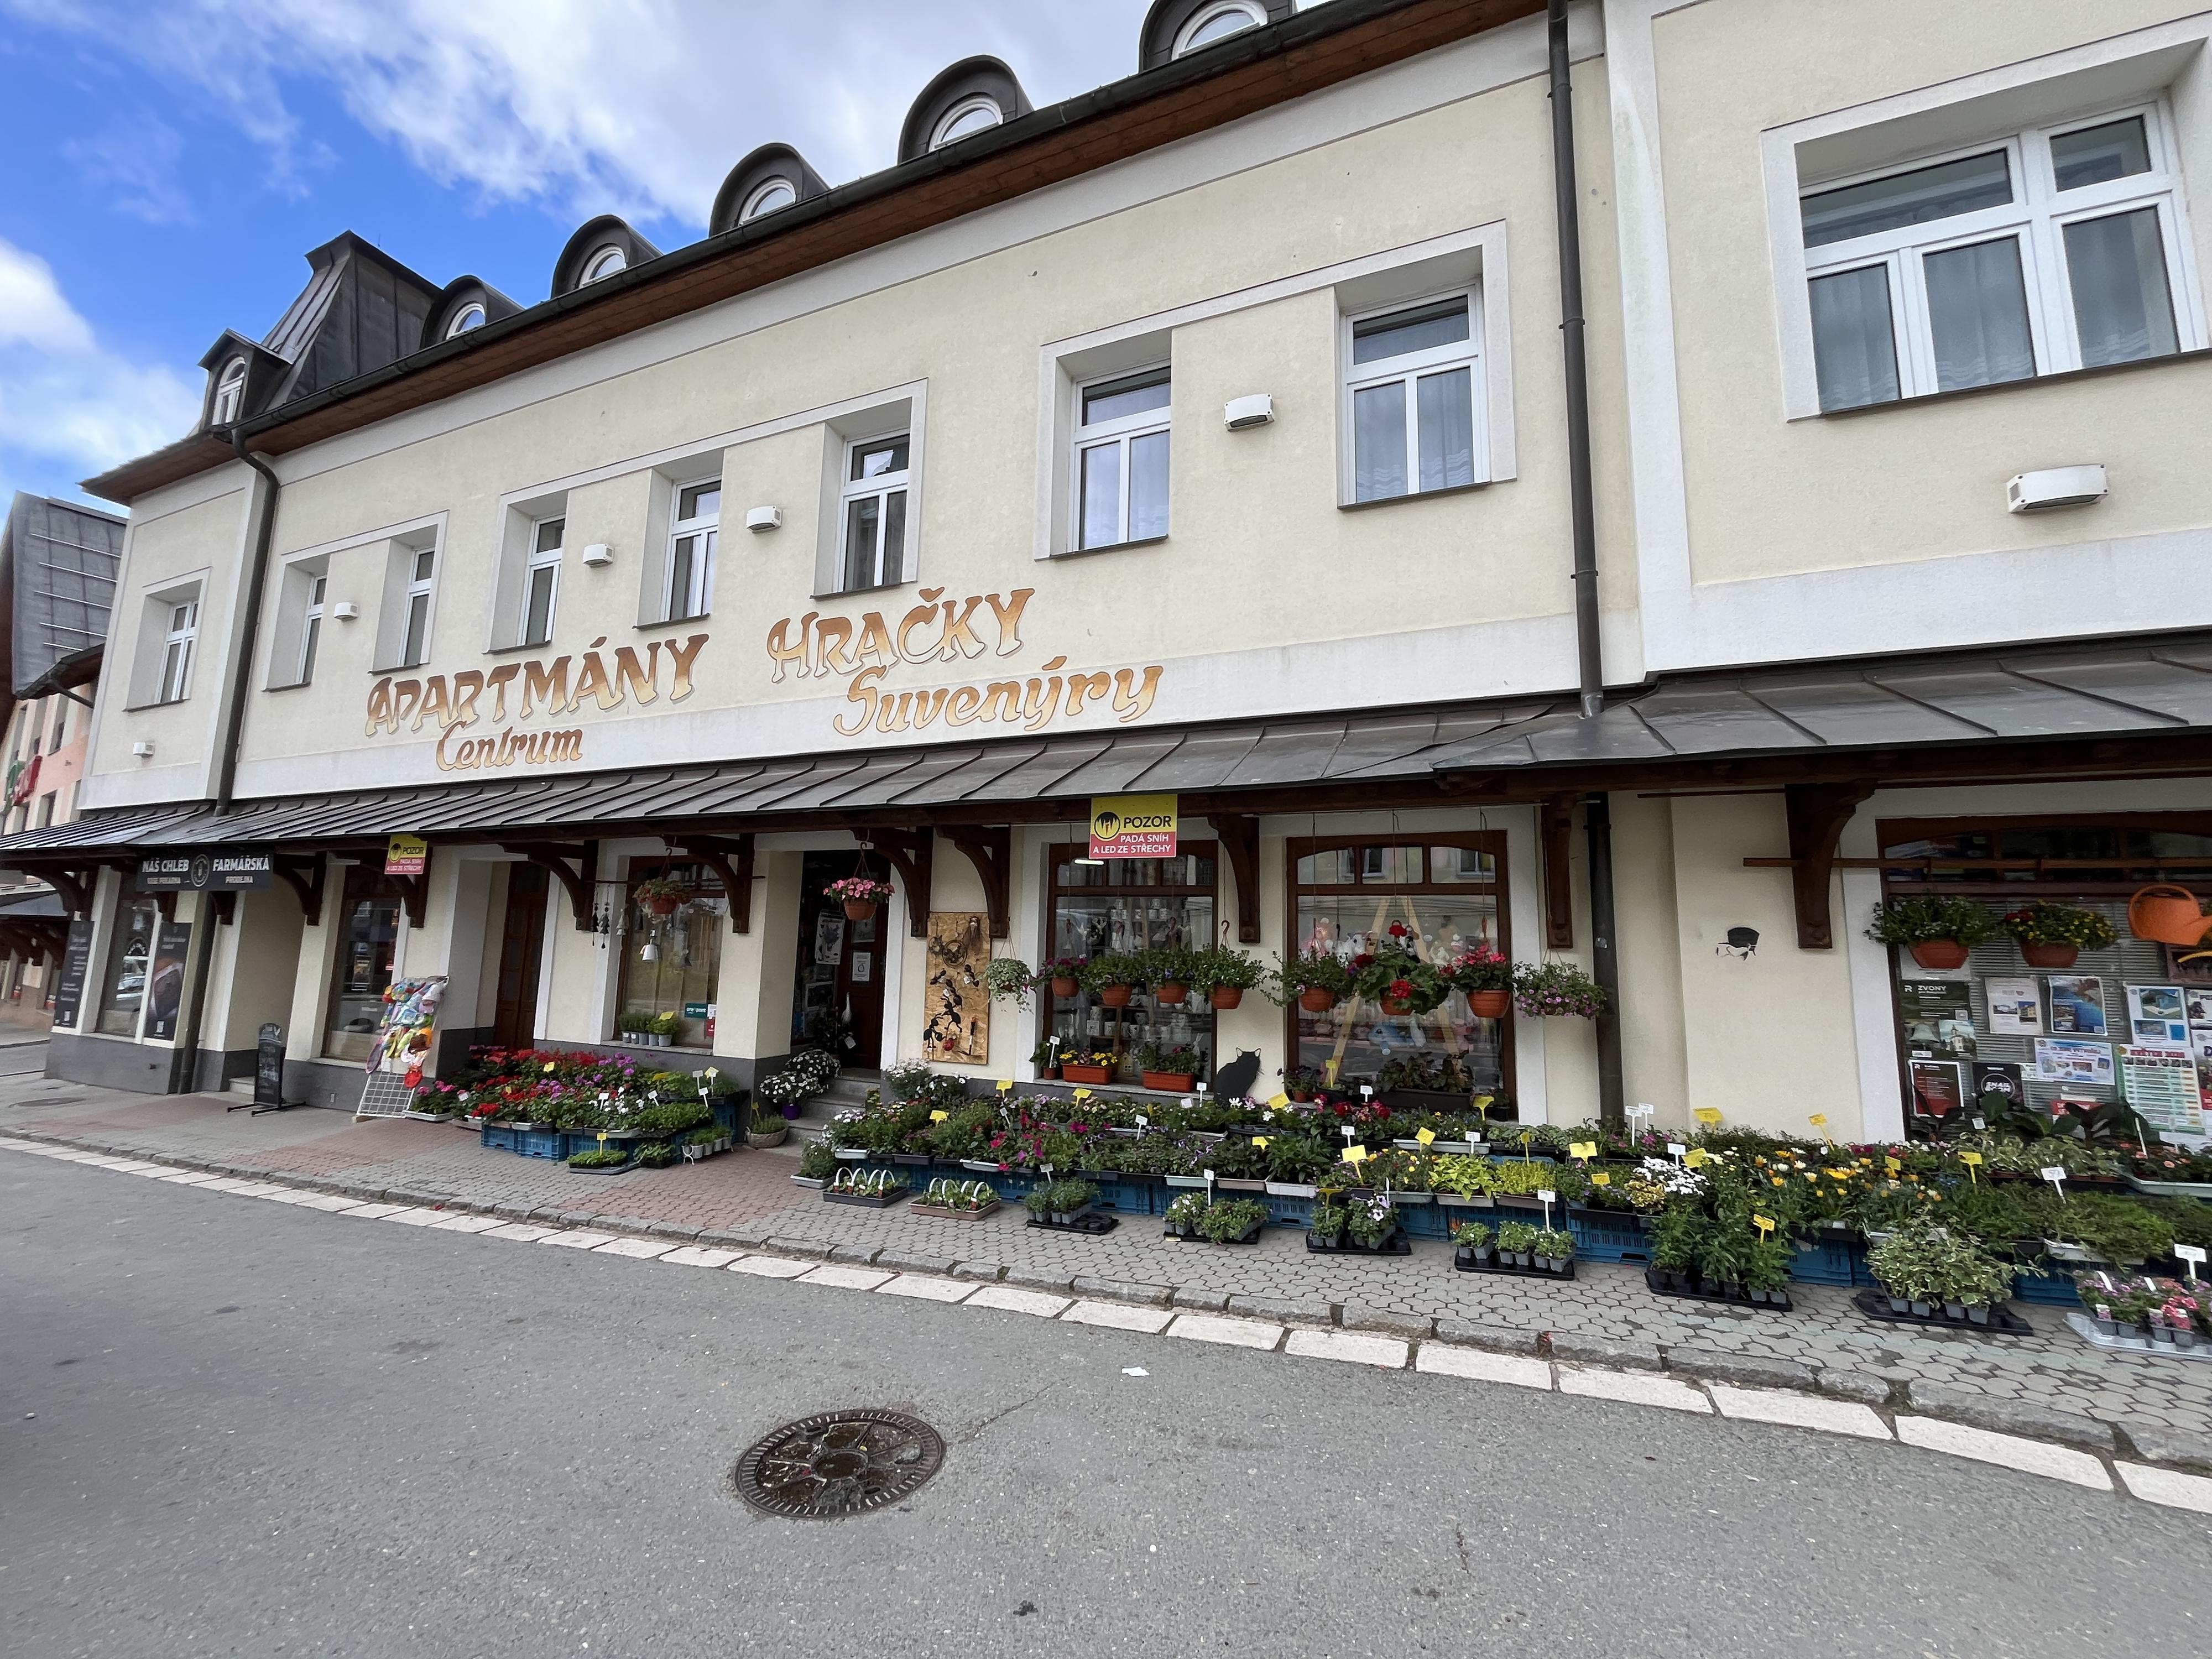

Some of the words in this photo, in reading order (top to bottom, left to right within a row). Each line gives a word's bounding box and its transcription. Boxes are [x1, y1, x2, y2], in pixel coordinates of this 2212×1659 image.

[766, 586, 1035, 684] HRAČKY
[365, 634, 709, 737] APARTMÁNY
[833, 655, 1164, 737] Suvenýry
[436, 721, 583, 771] Centrum
[1120, 833, 1145, 843] PADÁ
[1147, 832, 1169, 843] SNÍH
[1123, 815, 1172, 828] POZOR
[142, 858, 160, 873] NÁŠ
[161, 857, 190, 872] CHLÉB
[212, 854, 270, 872] FARMÁŘSKÁ
[1092, 846, 1099, 854] A
[1101, 846, 1117, 854] LED
[1130, 843, 1171, 853] STŘECHY
